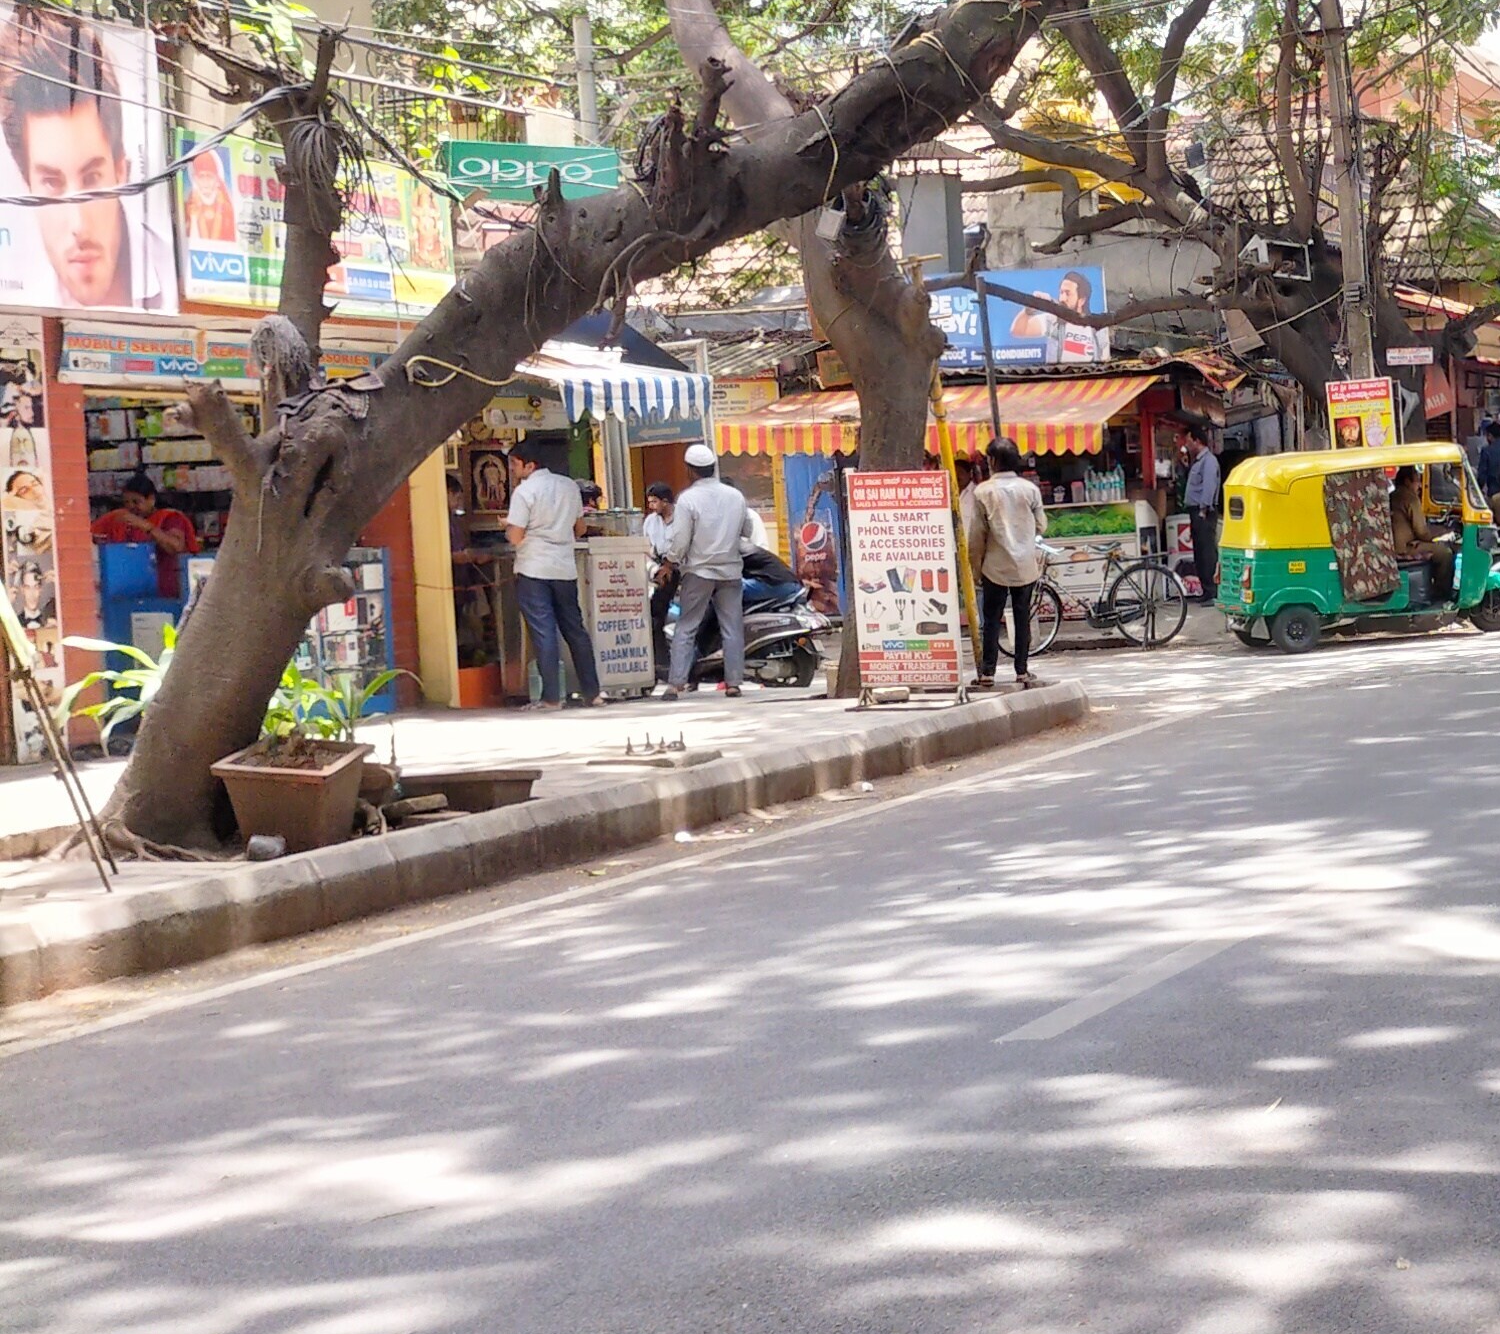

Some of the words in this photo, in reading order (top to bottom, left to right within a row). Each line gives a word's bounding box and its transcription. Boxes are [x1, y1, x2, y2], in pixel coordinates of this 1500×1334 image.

[66, 336, 126, 352] MOBILE
[130, 341, 193, 355] SERVICE
[912, 486, 945, 499] MOBILES
[870, 512, 890, 523] ALL
[893, 511, 931, 522] SMART
[857, 526, 895, 536] PHONE
[898, 524, 946, 535] SERVICE
[858, 539, 867, 549] &
[870, 537, 946, 548] ACCESSORIES
[861, 552, 883, 562] ARE
[885, 550, 946, 562] AVAILABLE
[615, 633, 632, 646] AND
[601, 647, 629, 662] BADAM
[629, 645, 649, 659] MILK
[884, 652, 912, 660] PAYTM
[915, 651, 933, 660] KYC
[606, 660, 649, 675] AVAILABLE
[869, 662, 901, 671] MONEY
[902, 661, 949, 670] TRANSFER
[868, 674, 899, 683] PHONE
[901, 673, 951, 682] RECHARGE
